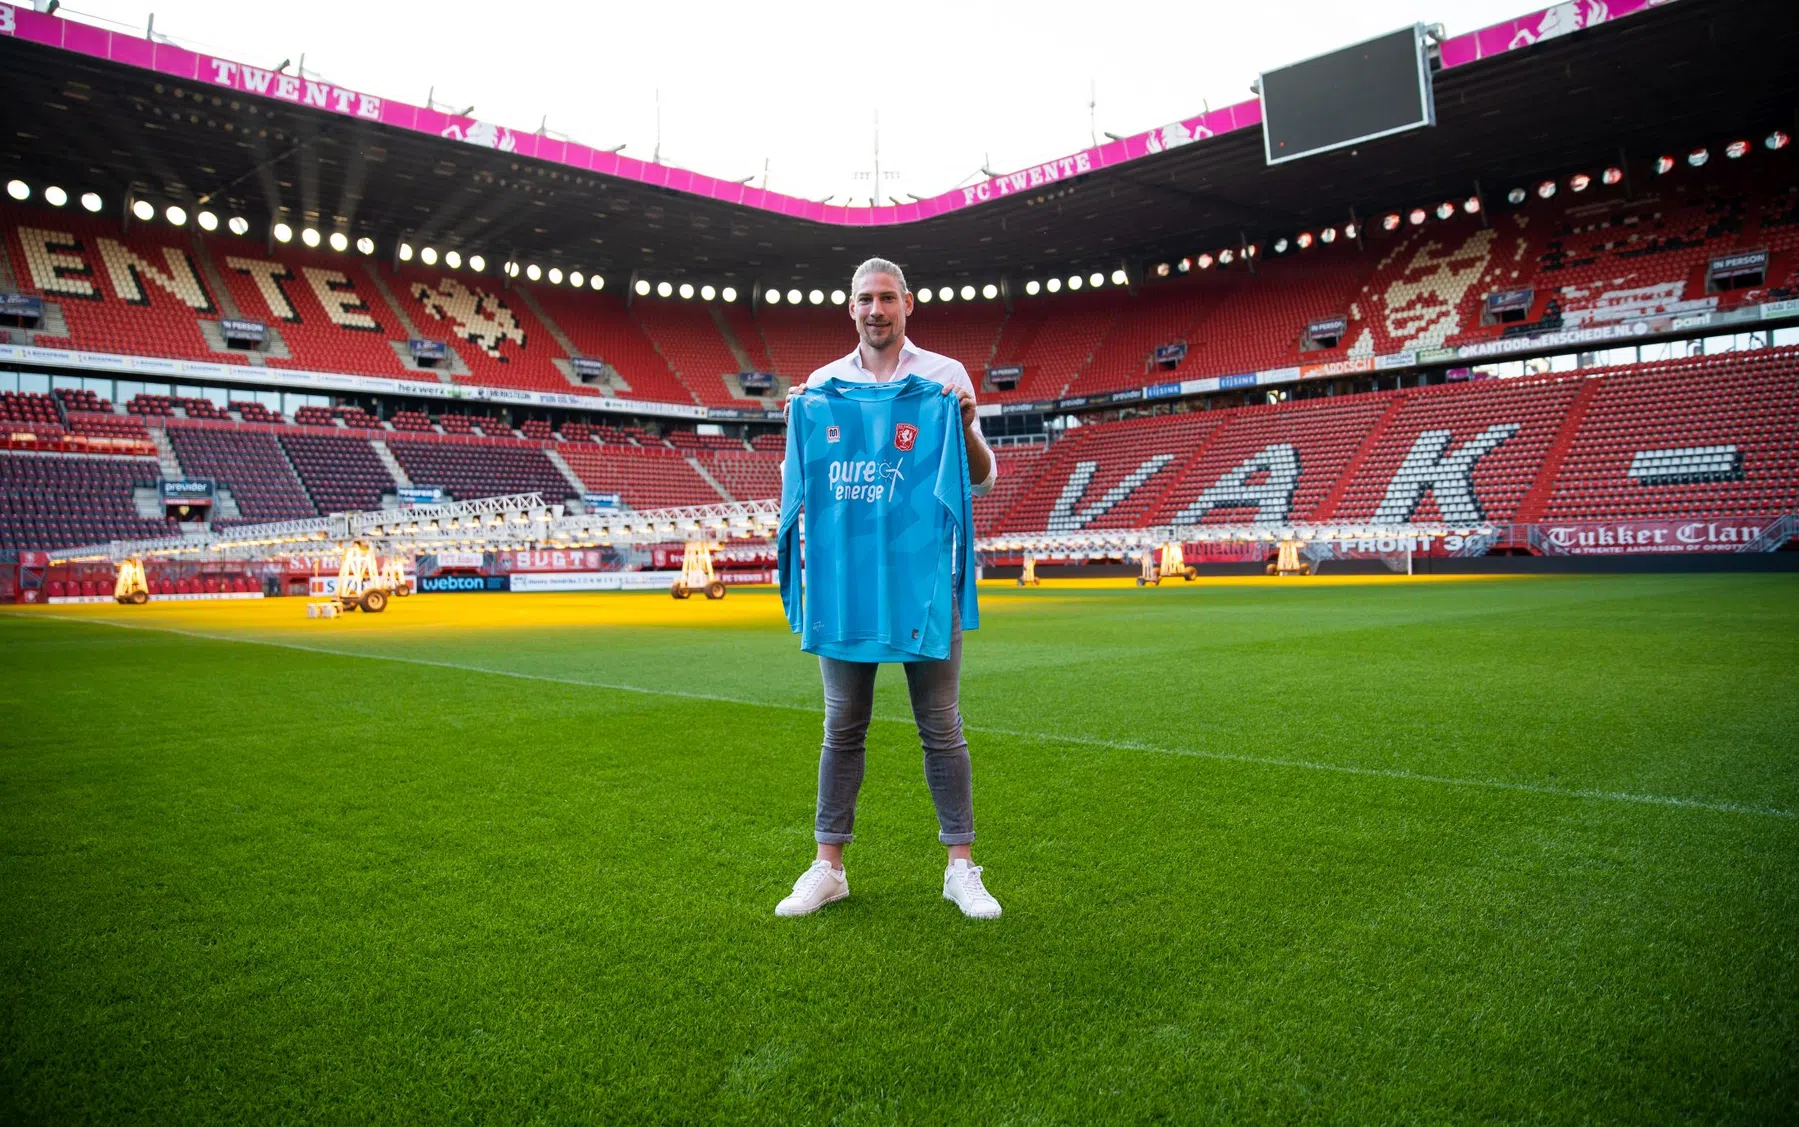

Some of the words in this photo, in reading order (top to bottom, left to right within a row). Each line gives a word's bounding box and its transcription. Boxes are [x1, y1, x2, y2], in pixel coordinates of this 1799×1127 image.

[212, 58, 381, 120] TWENTE
[963, 181, 991, 206] FC
[995, 153, 1092, 195] TWENTE
[1712, 260, 1725, 270] IN
[1725, 254, 1766, 268] PERSON
[232, 321, 264, 332] PERSON
[1672, 312, 1712, 331] paint
[828, 460, 876, 491] pure
[835, 484, 884, 503] energe
[1549, 524, 1669, 547] Tukker
[1675, 522, 1763, 544] Clan
[1341, 536, 1436, 553] FRONT
[422, 575, 484, 590] webton
